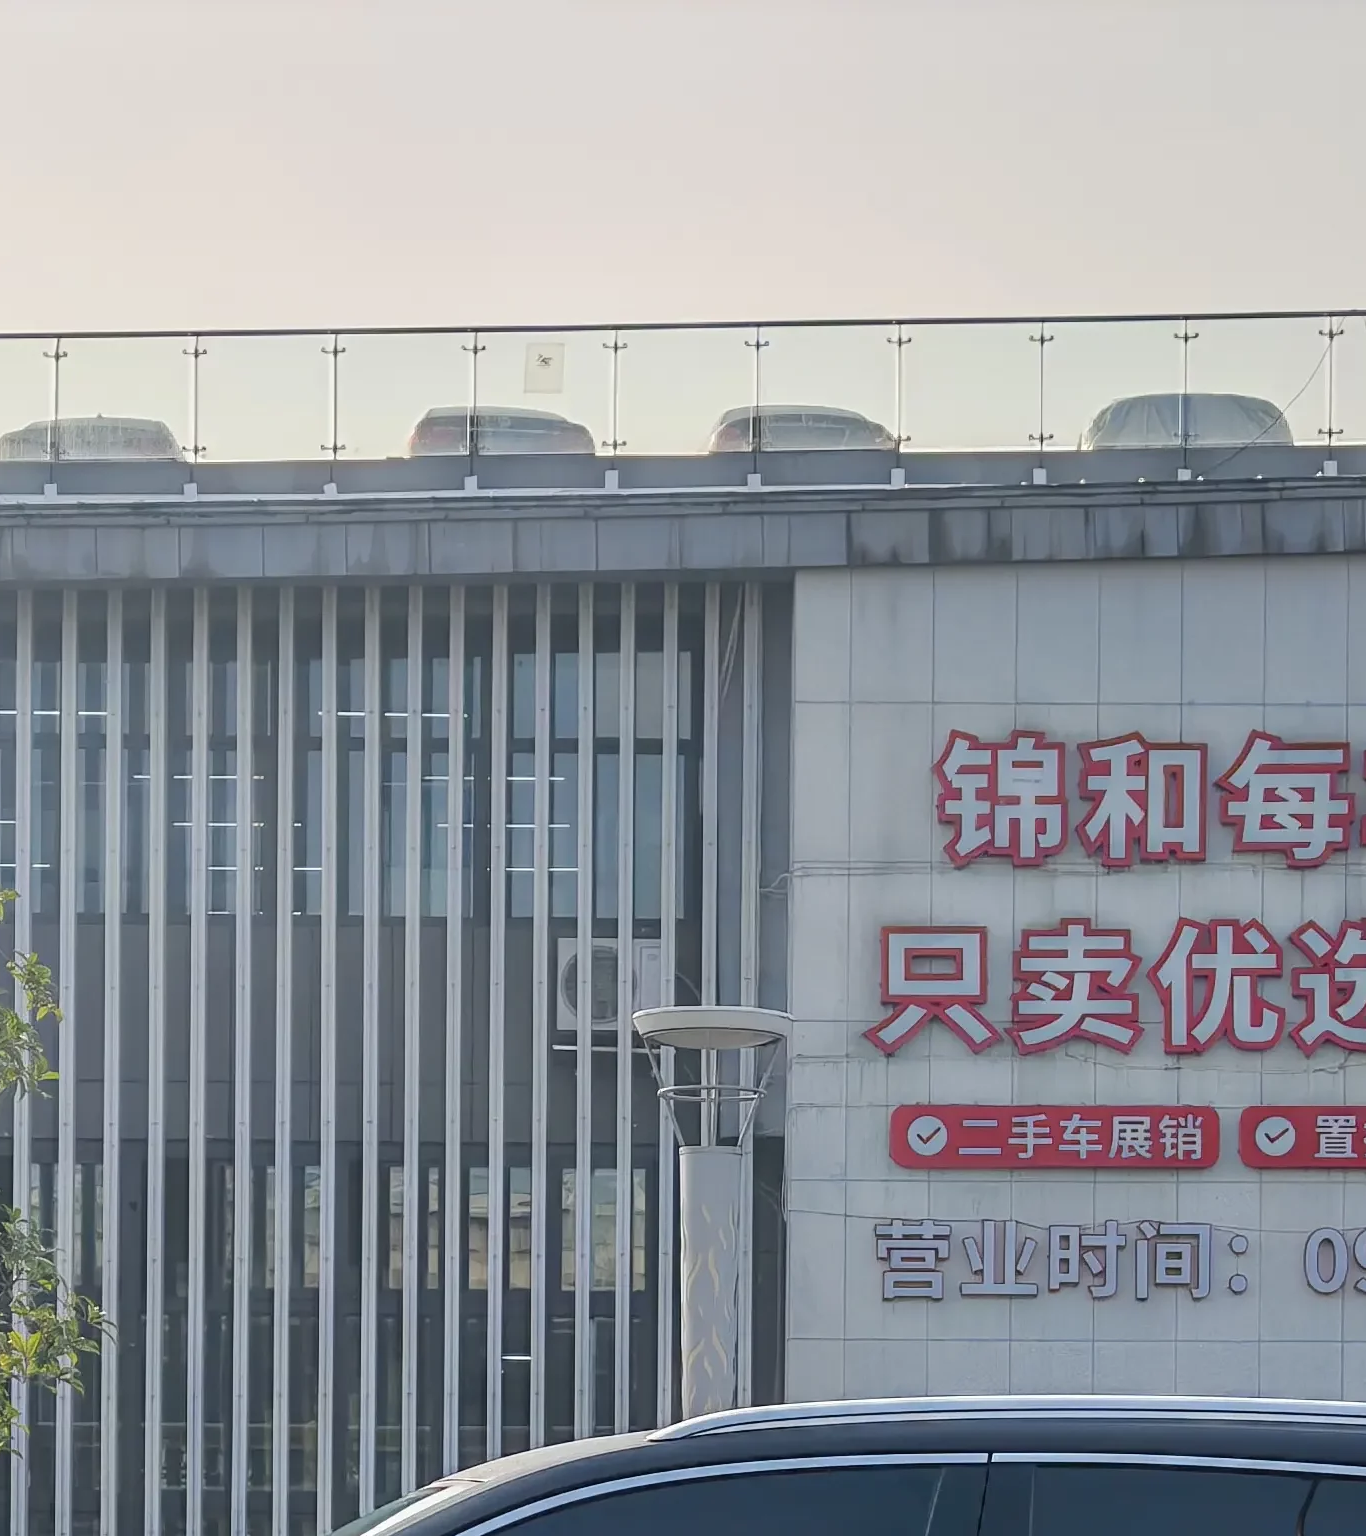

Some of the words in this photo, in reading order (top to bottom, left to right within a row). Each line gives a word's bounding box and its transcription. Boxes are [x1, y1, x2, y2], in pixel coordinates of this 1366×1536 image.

[957, 1115, 1205, 1161] 二手车展销
